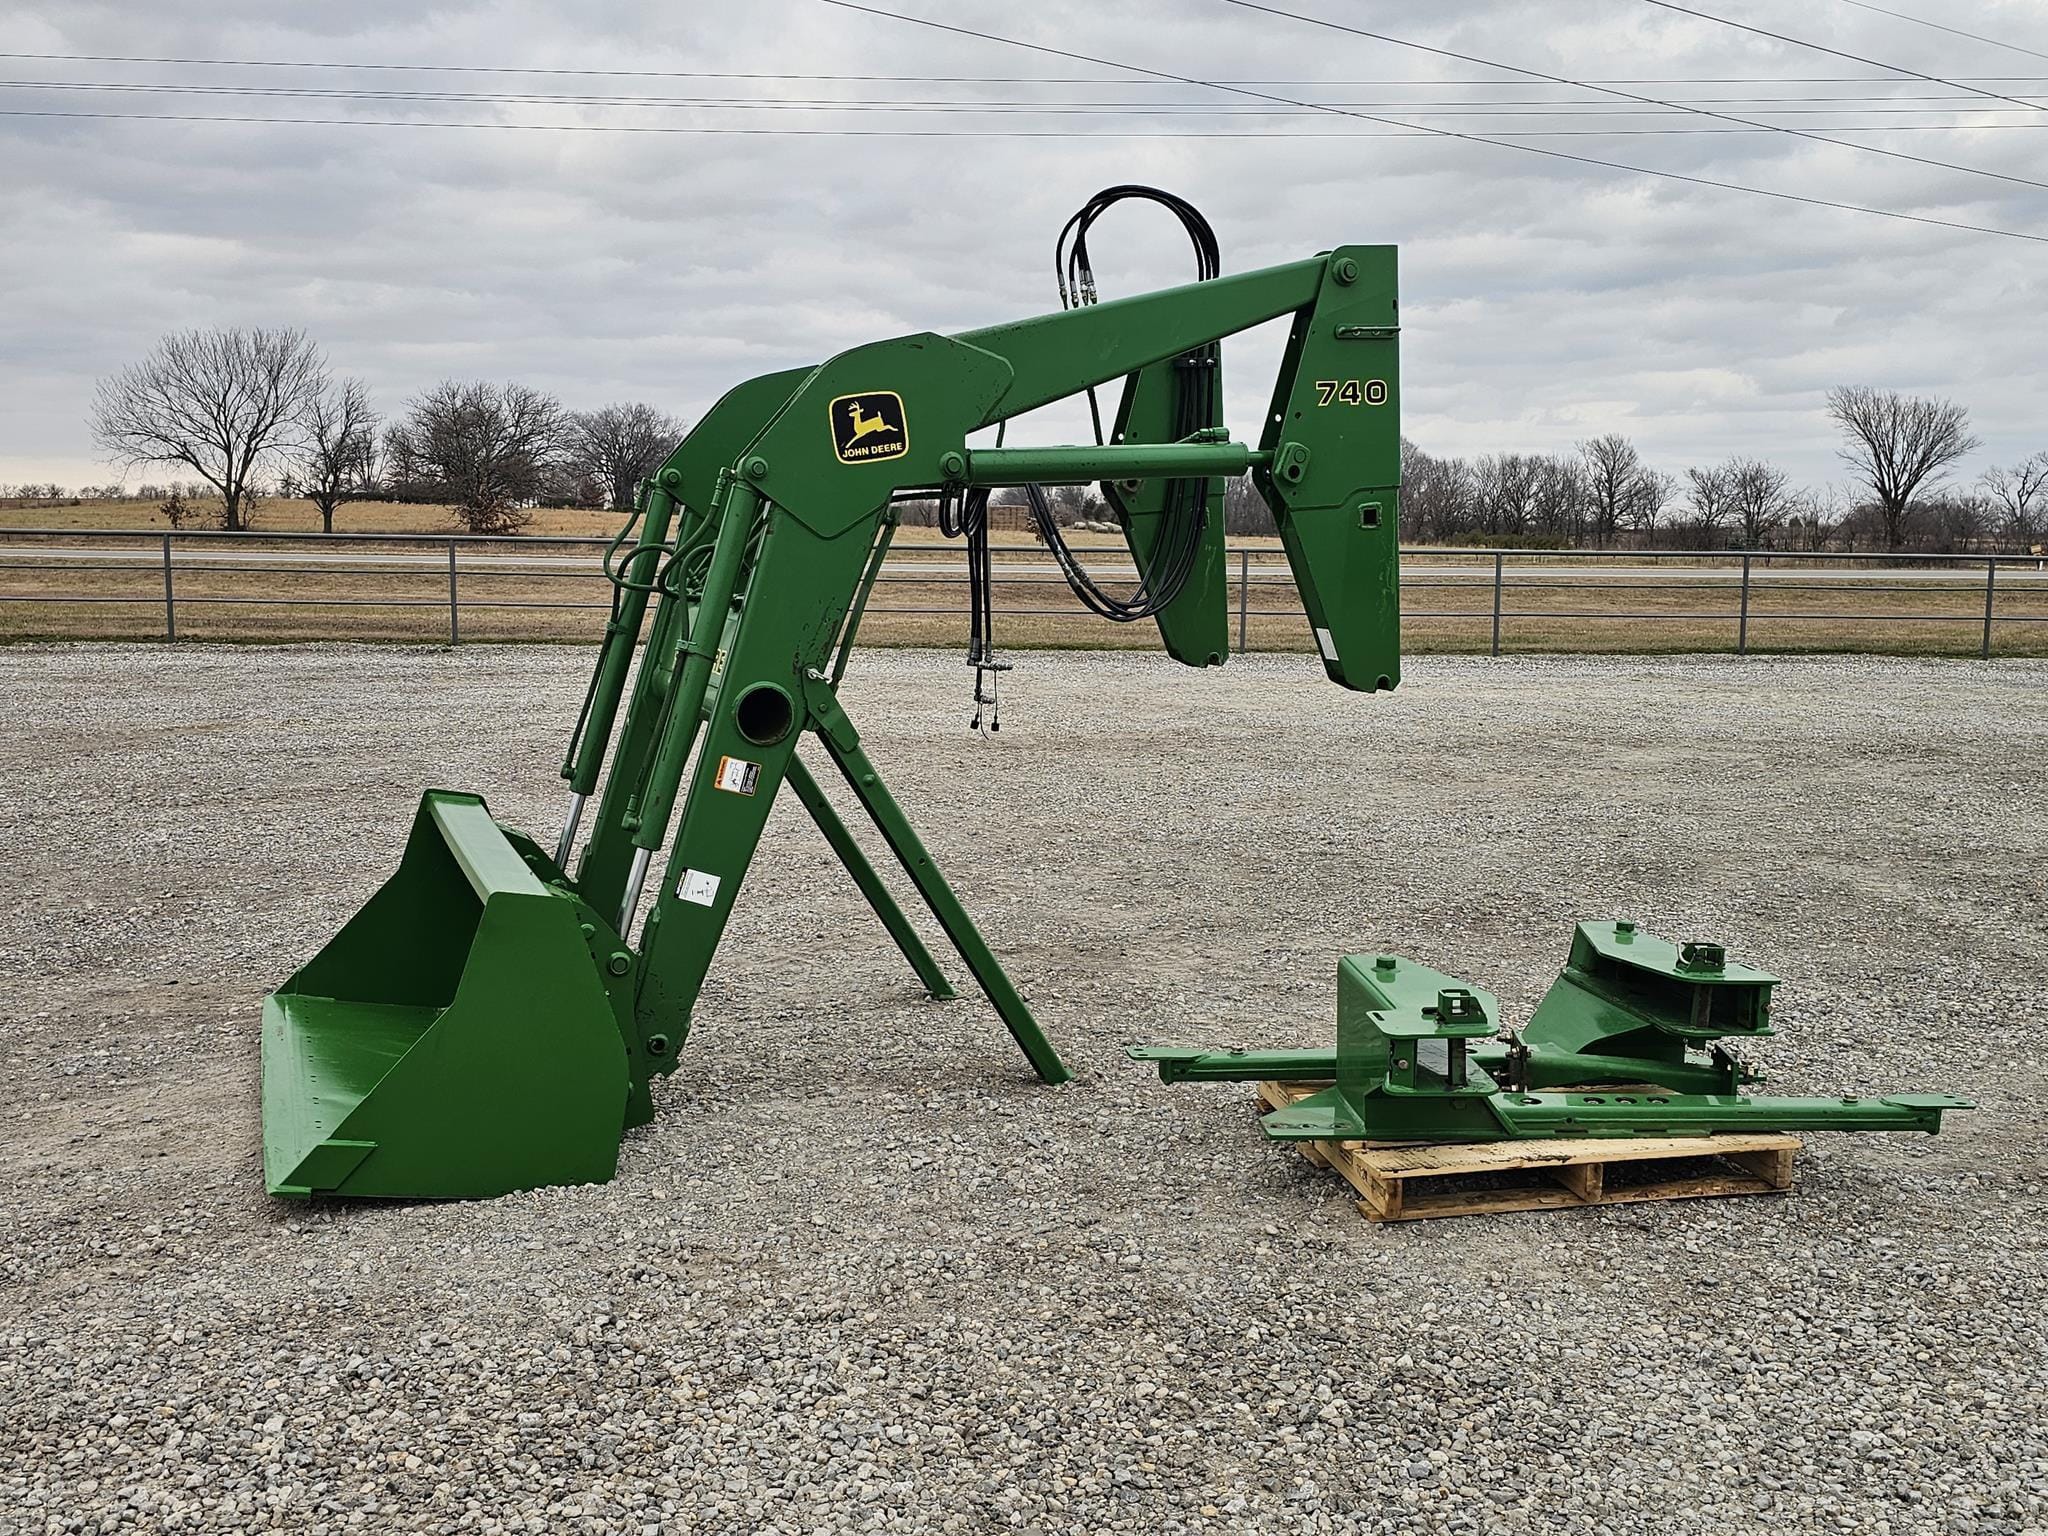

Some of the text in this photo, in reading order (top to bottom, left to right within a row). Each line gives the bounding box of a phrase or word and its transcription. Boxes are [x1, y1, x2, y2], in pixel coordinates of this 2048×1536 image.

[1316, 379, 1388, 406] 740
[842, 442, 903, 458] JOHN DEERE
